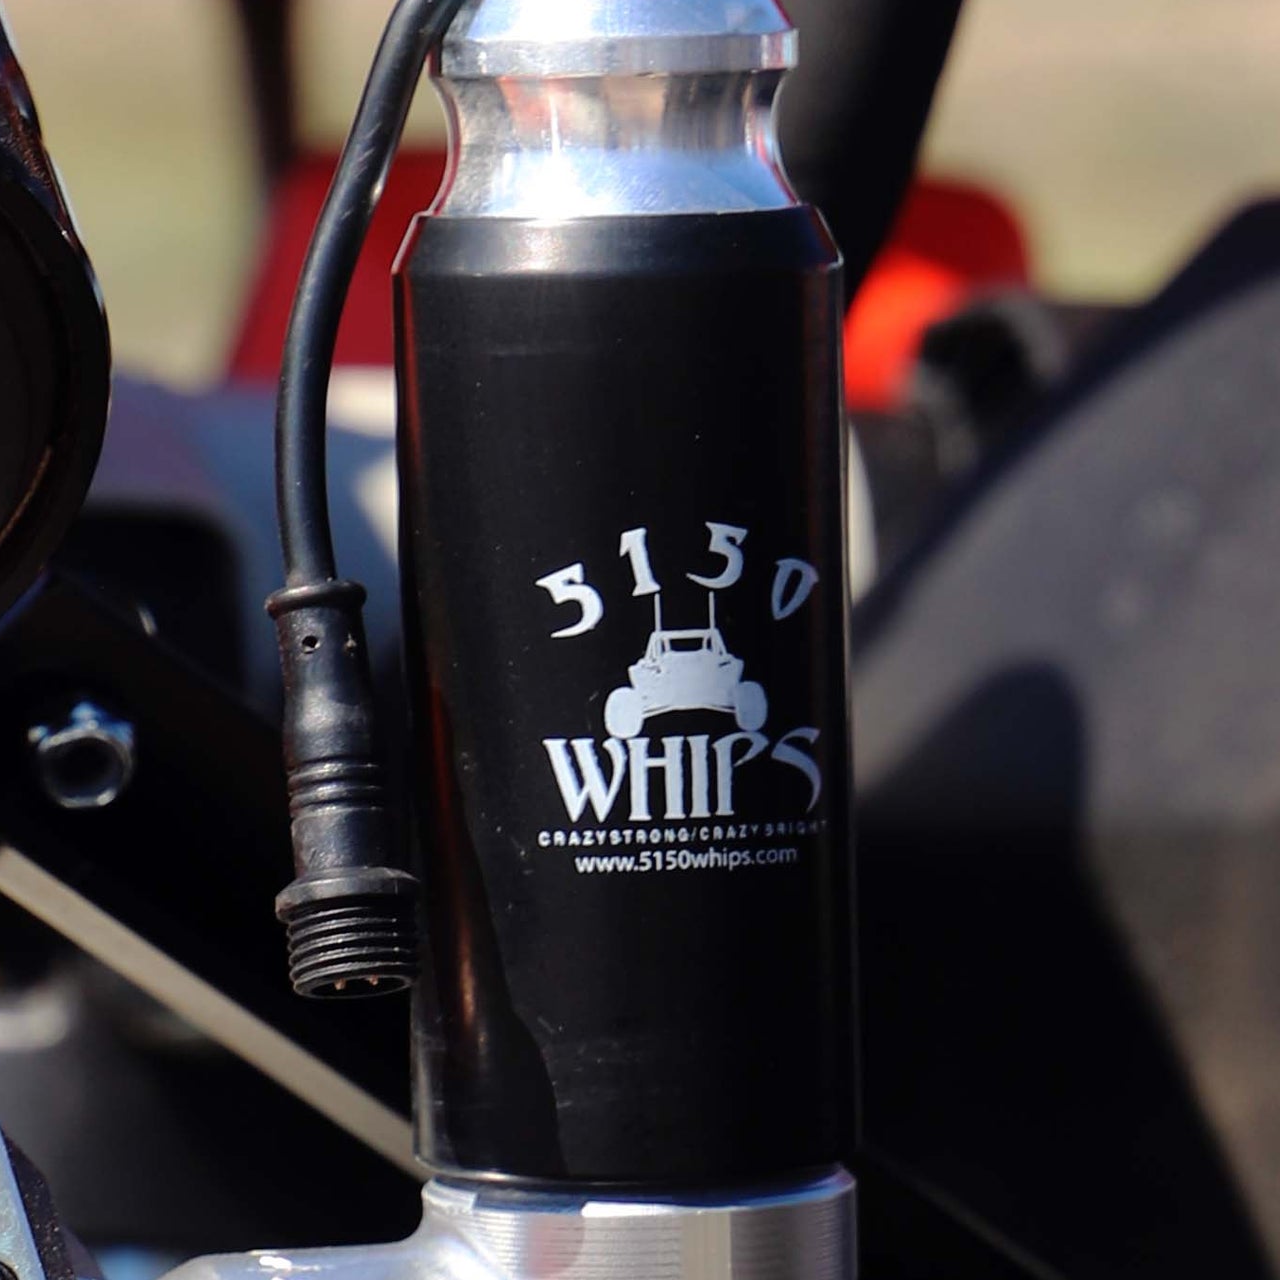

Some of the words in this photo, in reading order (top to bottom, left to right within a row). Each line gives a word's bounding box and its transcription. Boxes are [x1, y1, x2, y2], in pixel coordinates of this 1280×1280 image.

[535, 521, 819, 638] 5150
[542, 727, 821, 823] WHIPS
[574, 846, 798, 874] www.5150whips.com
